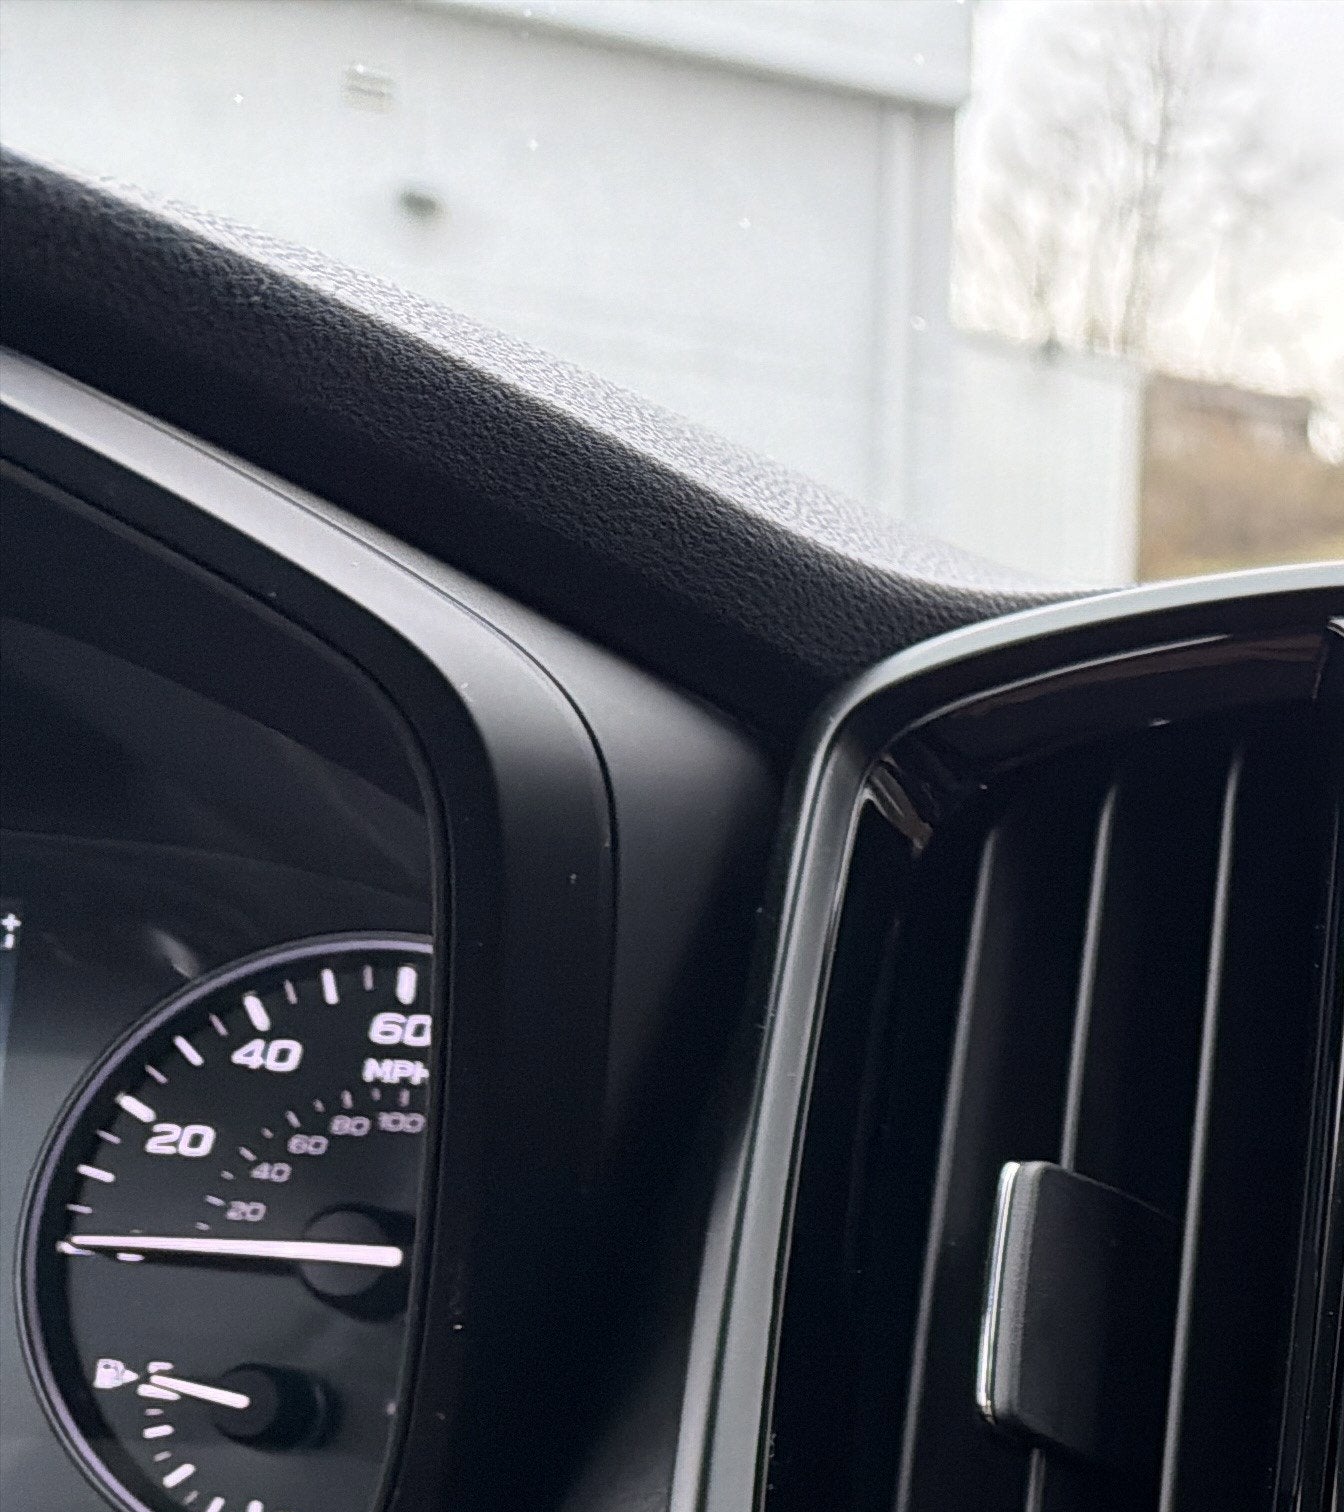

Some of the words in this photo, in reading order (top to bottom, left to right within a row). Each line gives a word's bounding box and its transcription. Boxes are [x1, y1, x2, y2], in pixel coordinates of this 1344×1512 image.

[369, 1013, 432, 1046] 60
[232, 1039, 302, 1071] 40
[331, 1115, 370, 1136] 80
[379, 1112, 425, 1133] 100
[146, 1124, 215, 1157] 20
[288, 1134, 328, 1154] 60
[252, 1163, 291, 1182] 40
[226, 1201, 266, 1221] 20
